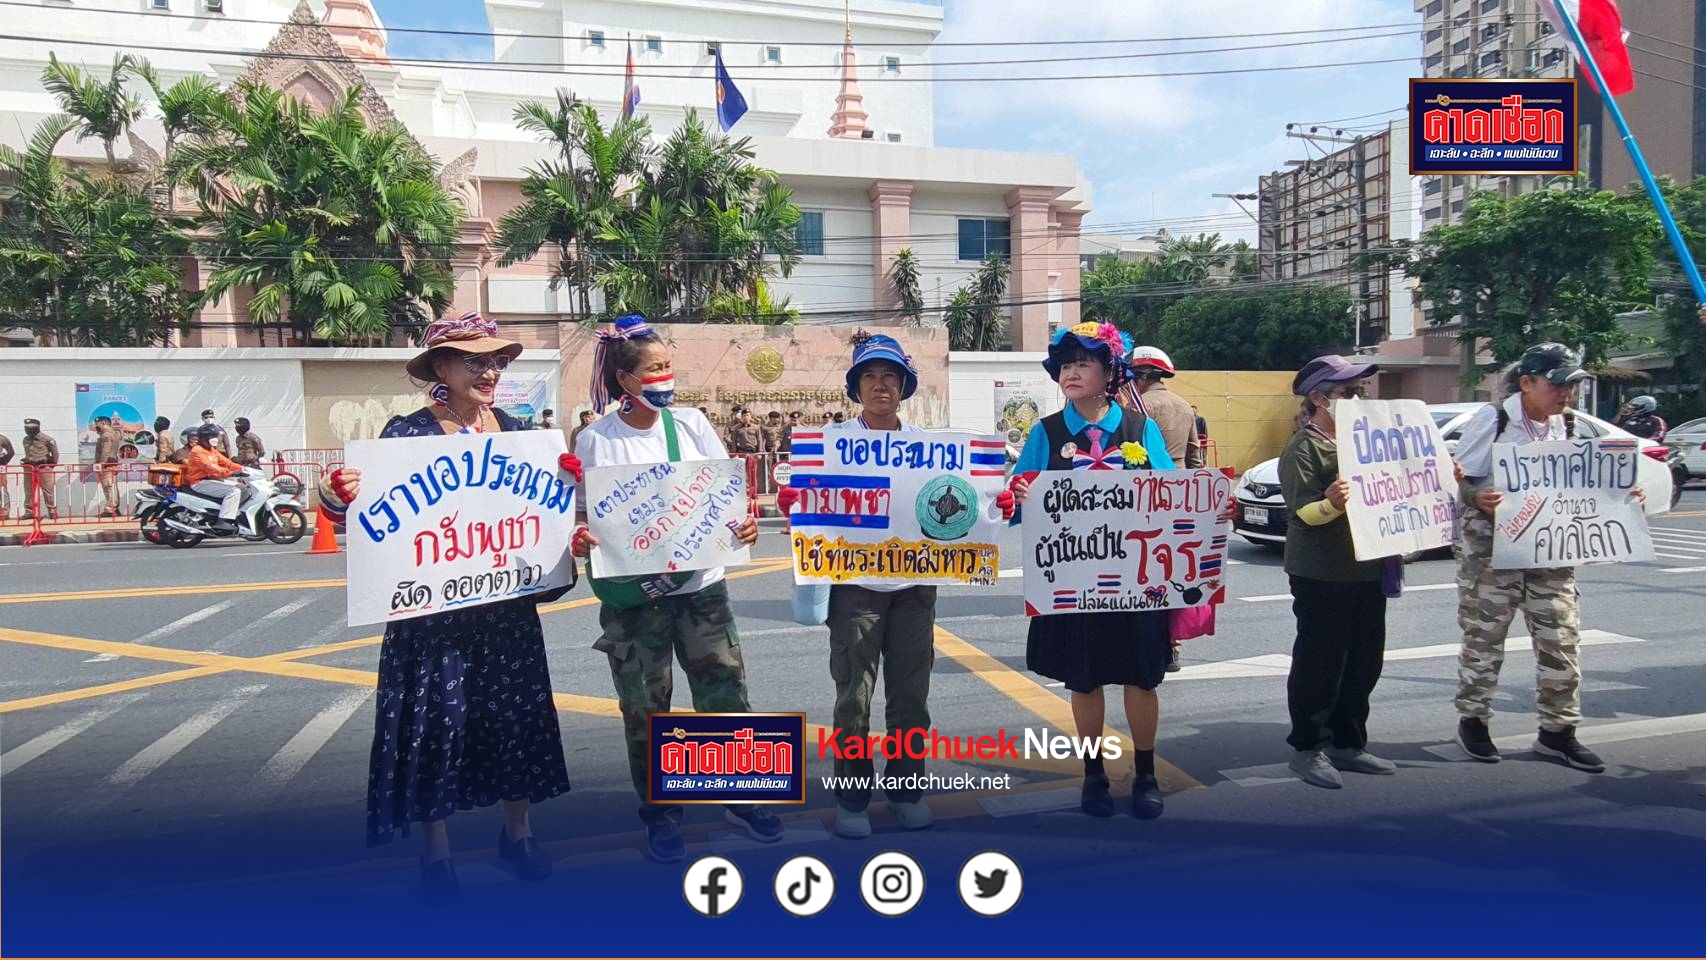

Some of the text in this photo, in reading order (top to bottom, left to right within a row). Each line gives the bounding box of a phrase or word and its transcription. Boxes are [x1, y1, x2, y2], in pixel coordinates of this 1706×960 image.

[836, 432, 964, 471] ขอประณาม
[1500, 441, 1638, 493] ประเทศไทย
[358, 437, 575, 543] เราขอประณาม
[1552, 494, 1597, 515] อำนาจ
[413, 506, 540, 568] กัมพูชา
[1534, 514, 1633, 564] ศาลโลก
